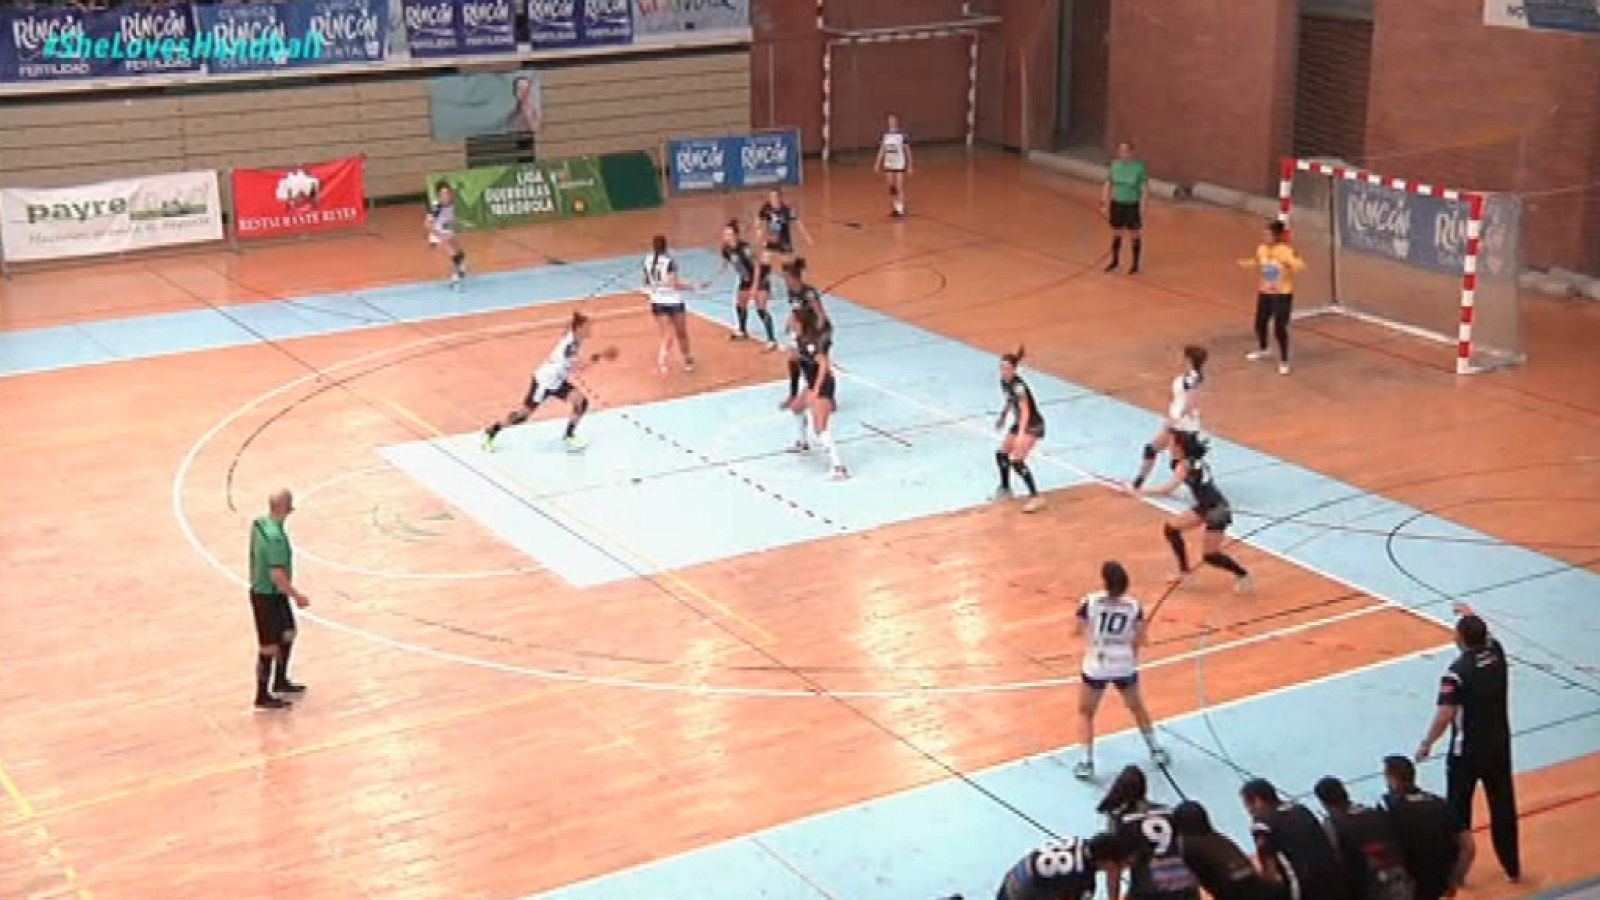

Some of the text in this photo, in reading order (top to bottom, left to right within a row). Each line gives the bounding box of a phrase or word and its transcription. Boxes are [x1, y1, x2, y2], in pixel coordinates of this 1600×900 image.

[26, 196, 127, 224] payre
[1099, 611, 1129, 635] 10
[1141, 816, 1173, 855] 9
